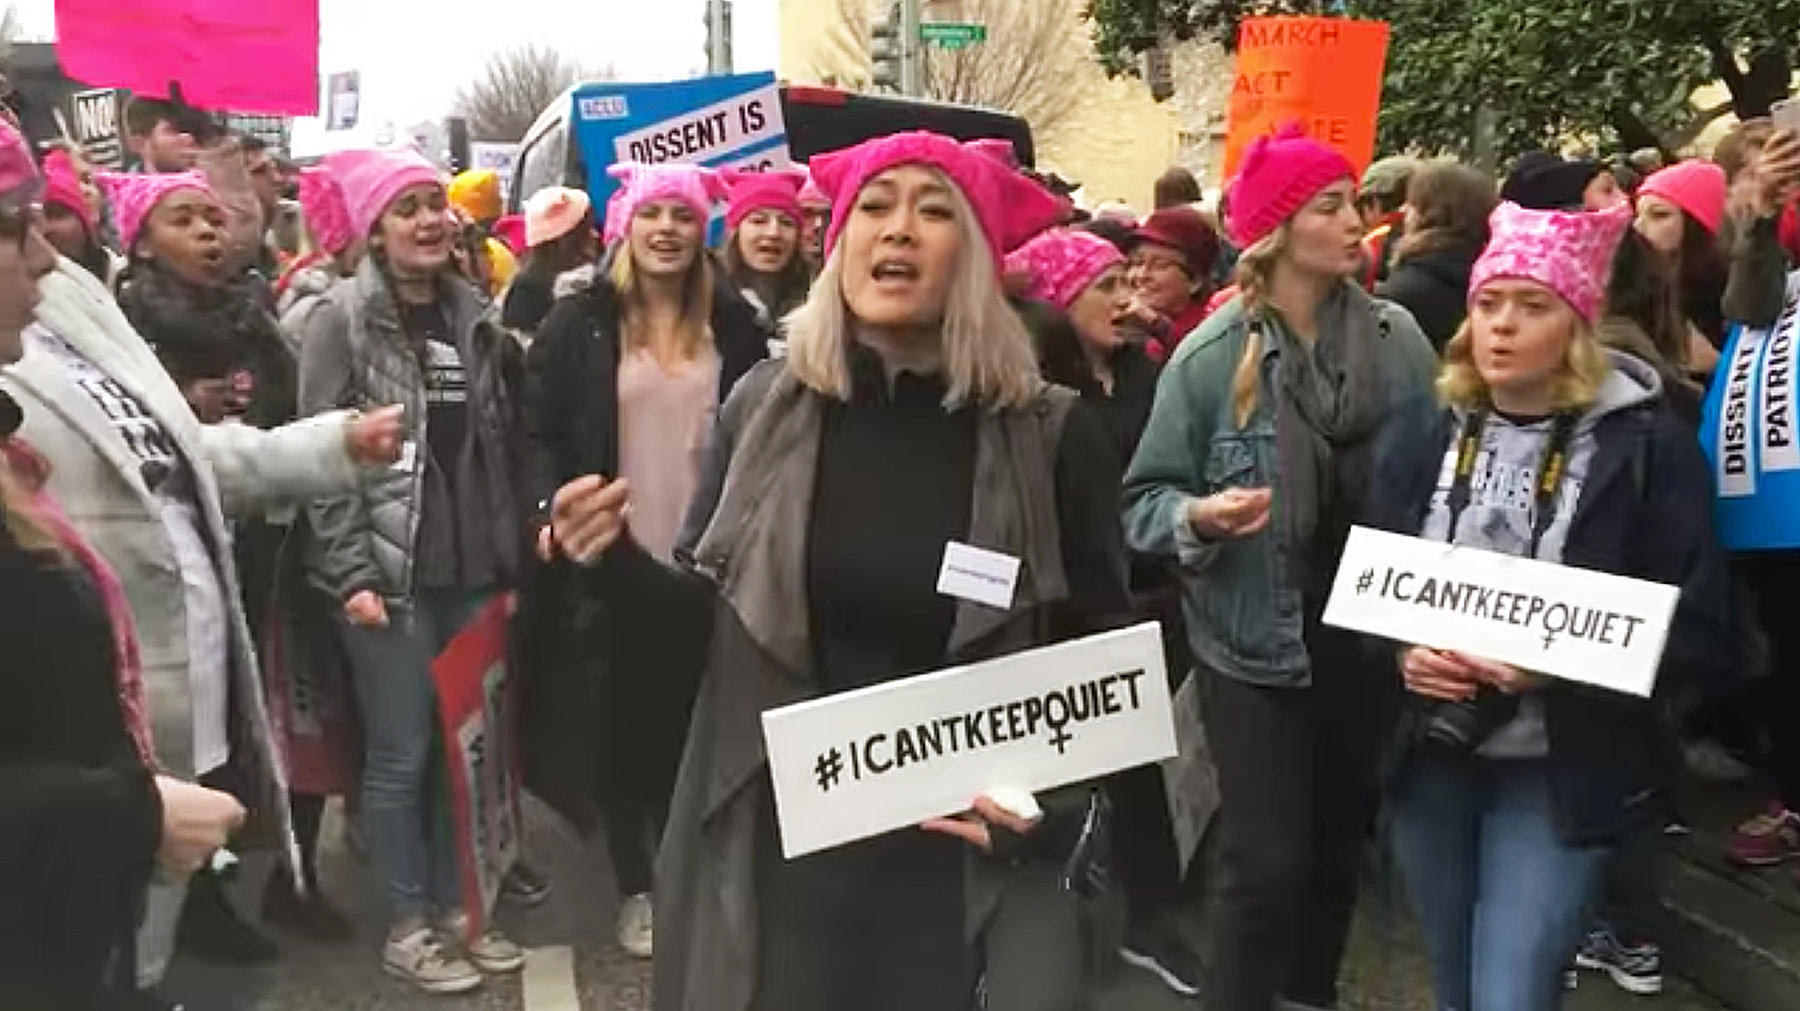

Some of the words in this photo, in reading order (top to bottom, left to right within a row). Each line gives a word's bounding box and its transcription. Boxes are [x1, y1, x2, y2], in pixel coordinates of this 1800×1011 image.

[1246, 22, 1340, 47] MARCH
[1233, 70, 1293, 95] ACT
[629, 112, 728, 165] DISSENT
[737, 100, 766, 135] IS
[1725, 346, 1755, 476] DISSENT
